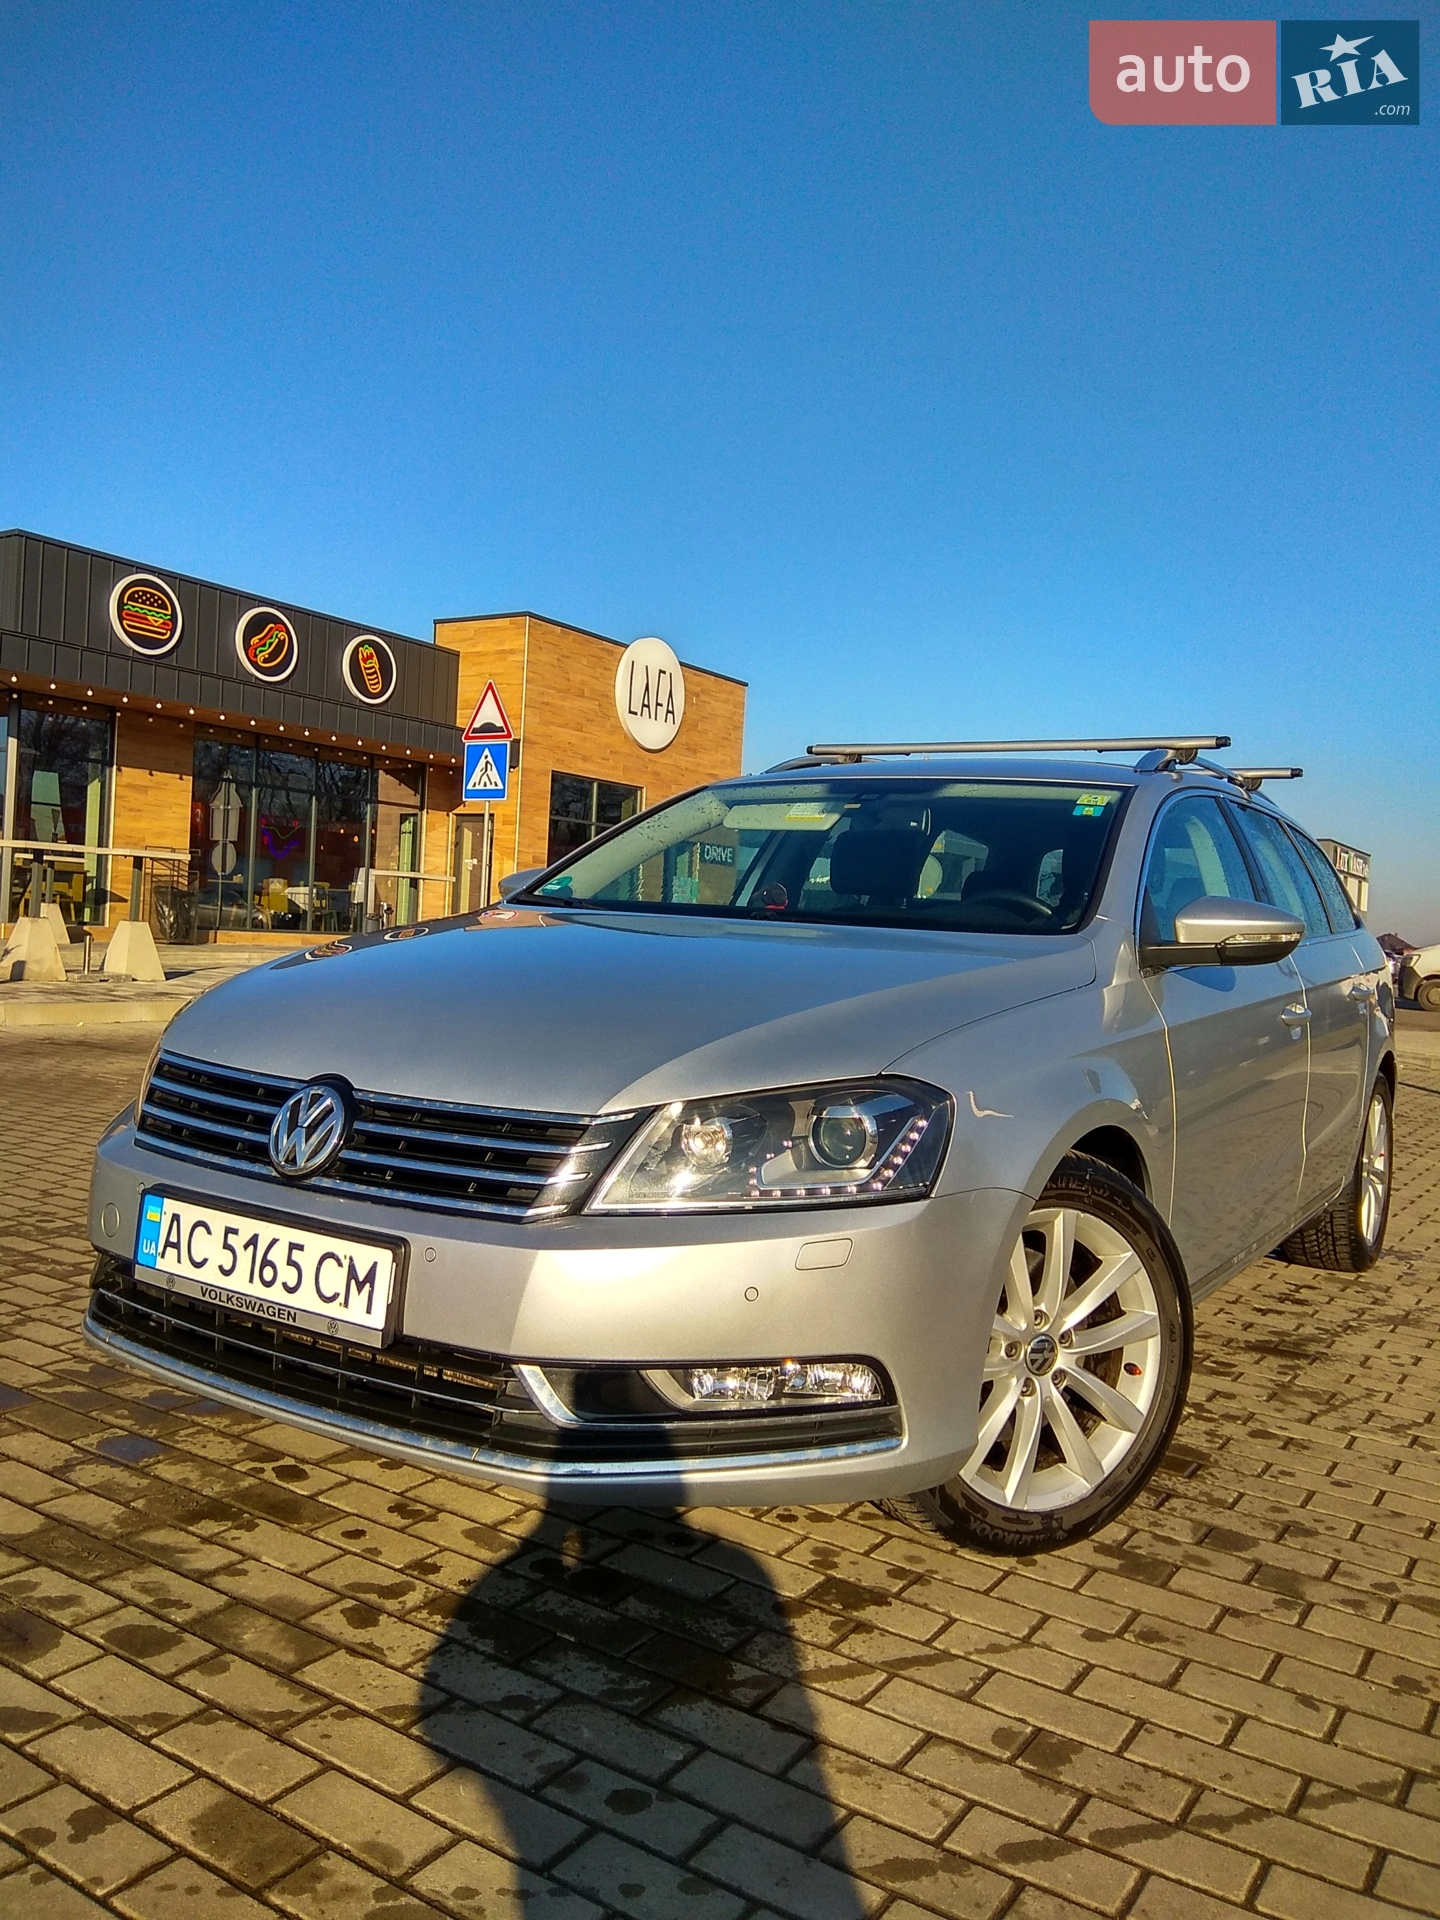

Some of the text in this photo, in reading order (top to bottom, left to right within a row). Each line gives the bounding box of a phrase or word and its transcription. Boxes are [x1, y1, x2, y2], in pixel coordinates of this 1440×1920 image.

[628, 660, 676, 725] LAFA
[704, 844, 733, 863] DRIVE
[143, 1239, 157, 1257] UA
[160, 1212, 378, 1315] AC 5165 CM
[200, 1286, 297, 1323] VOLKSWAGEN
